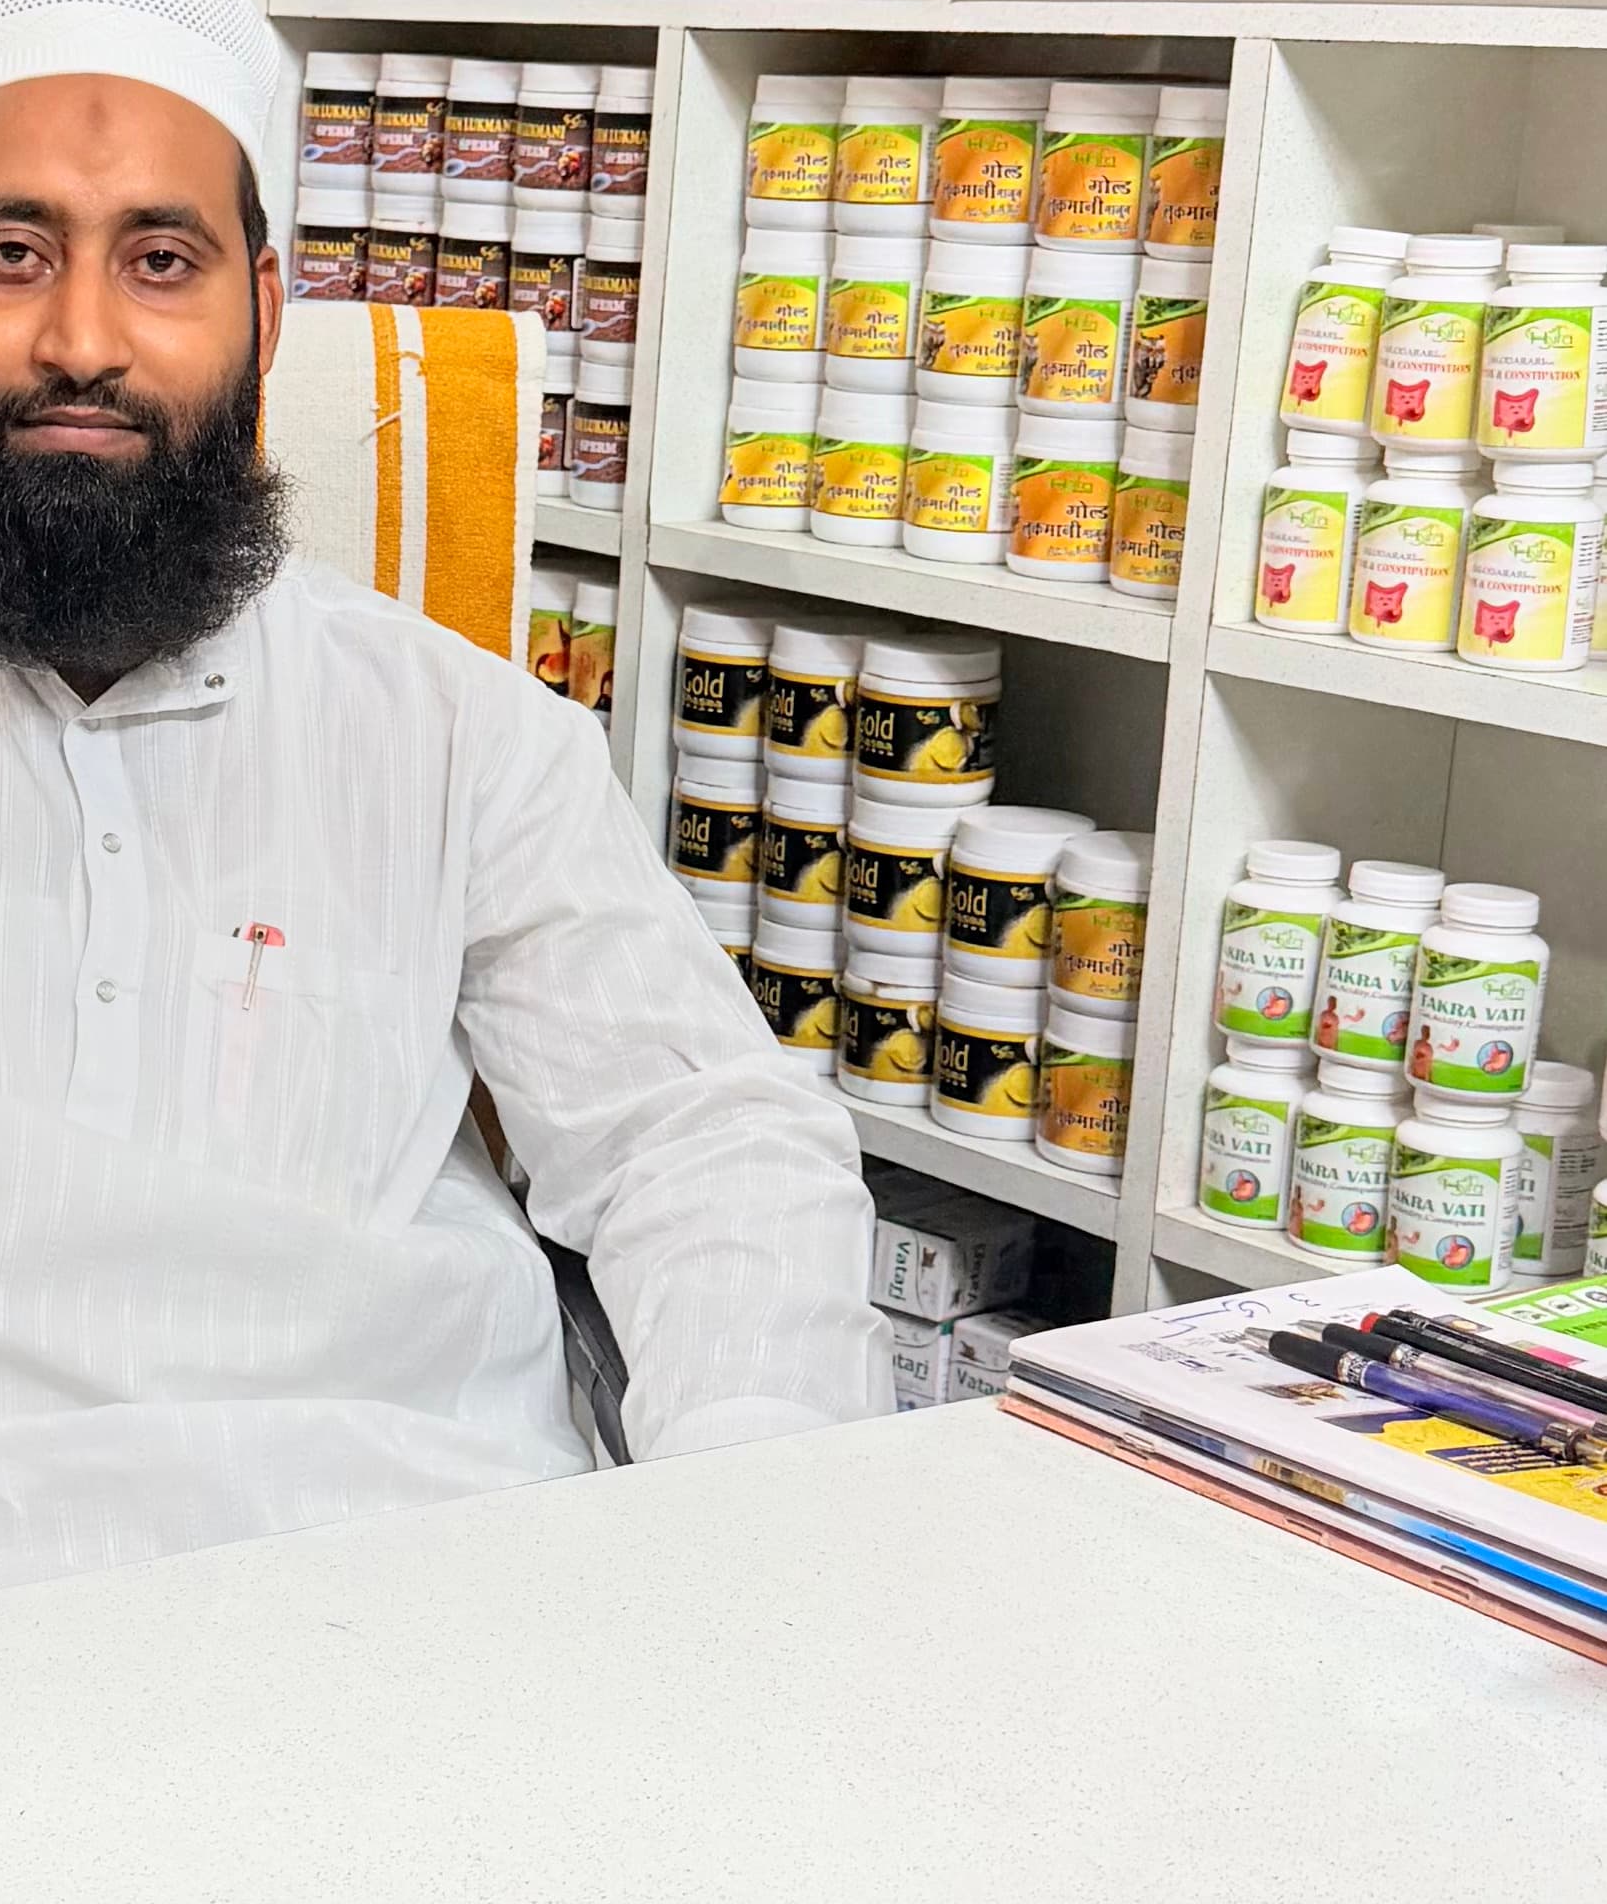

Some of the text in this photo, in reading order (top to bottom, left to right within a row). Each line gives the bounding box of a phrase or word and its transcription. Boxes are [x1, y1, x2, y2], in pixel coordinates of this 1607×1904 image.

[315, 126, 356, 138] SPERM
[1505, 367, 1582, 383] CONSTIPATION
[684, 670, 724, 700] Gold
[1263, 953, 1305, 972] VATI
[1419, 992, 1526, 1023] TAKRA VATI
[888, 1241, 912, 1302] Vatari
